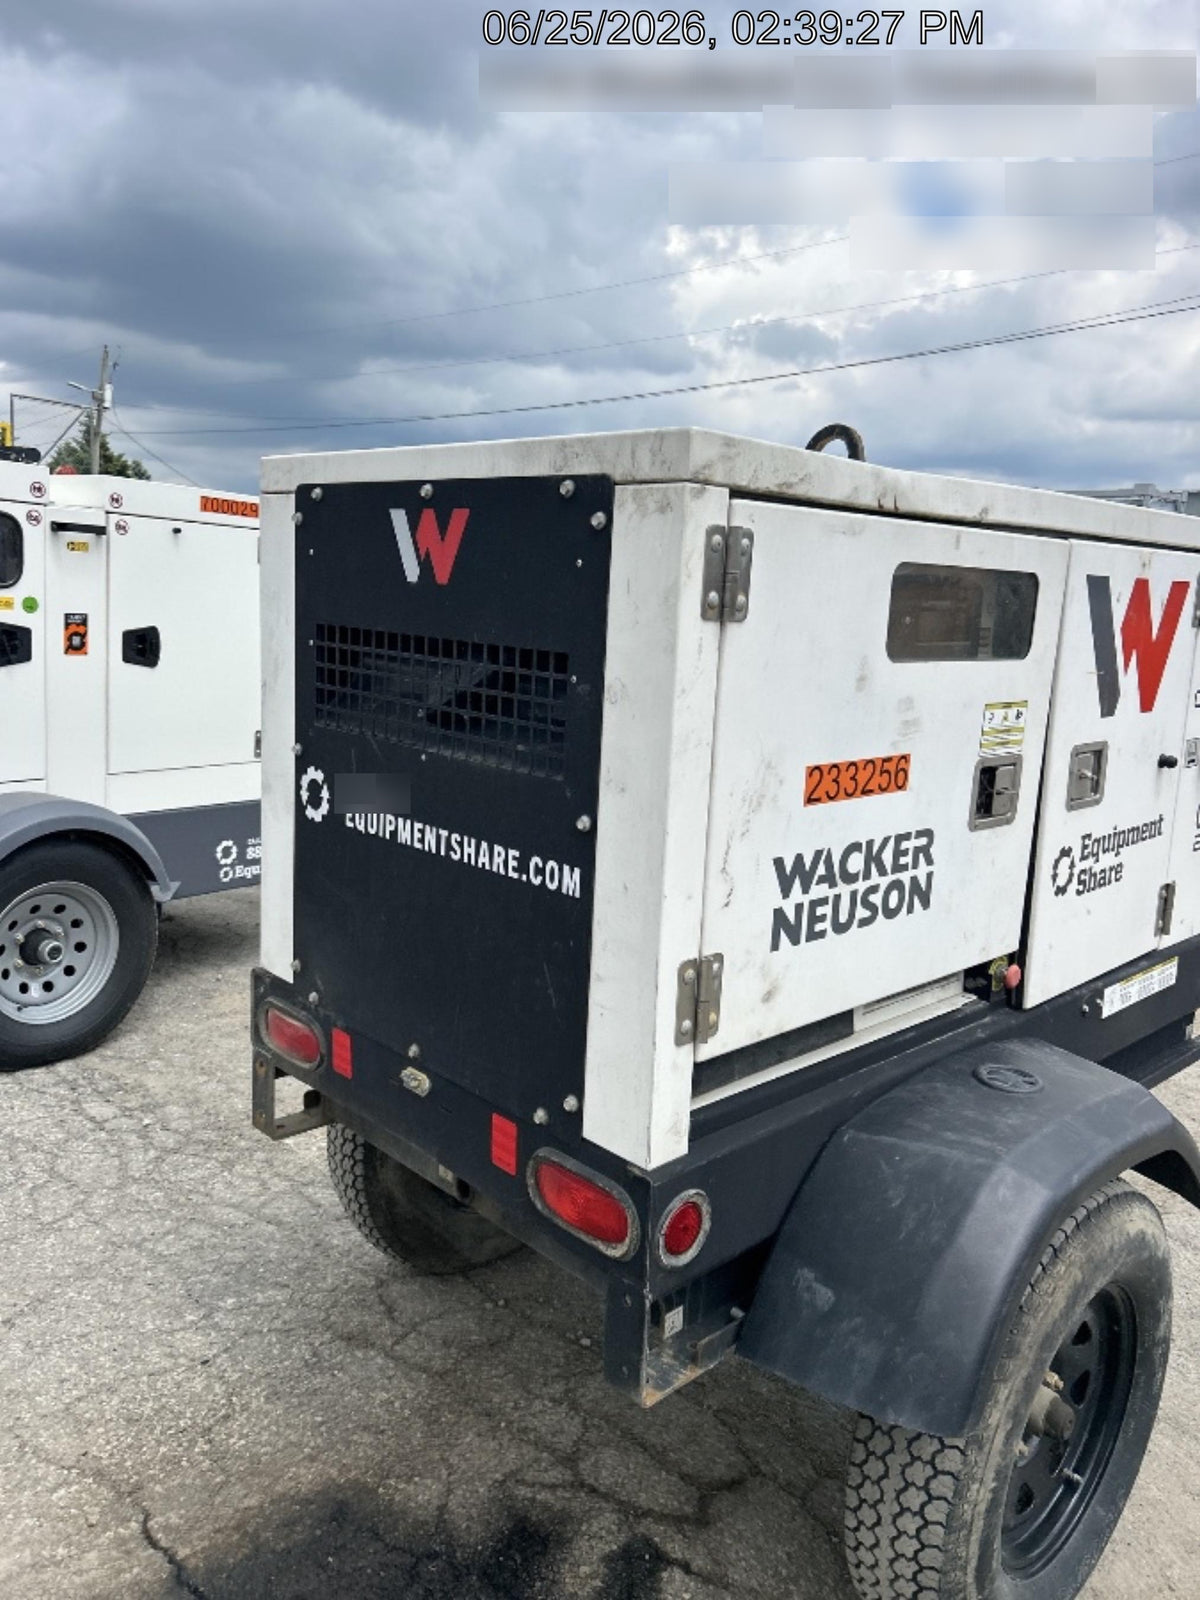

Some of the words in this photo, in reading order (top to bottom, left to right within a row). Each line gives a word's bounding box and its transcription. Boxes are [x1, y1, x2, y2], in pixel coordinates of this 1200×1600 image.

[200, 496, 258, 518] 700029
[806, 754, 908, 804] 233256
[344, 813, 582, 899] EQUIPMENTSHARE.COM
[772, 828, 935, 900] WACKER
[1079, 813, 1164, 864] Equipment
[1075, 862, 1124, 896] Share
[770, 871, 934, 953] NEUSON
